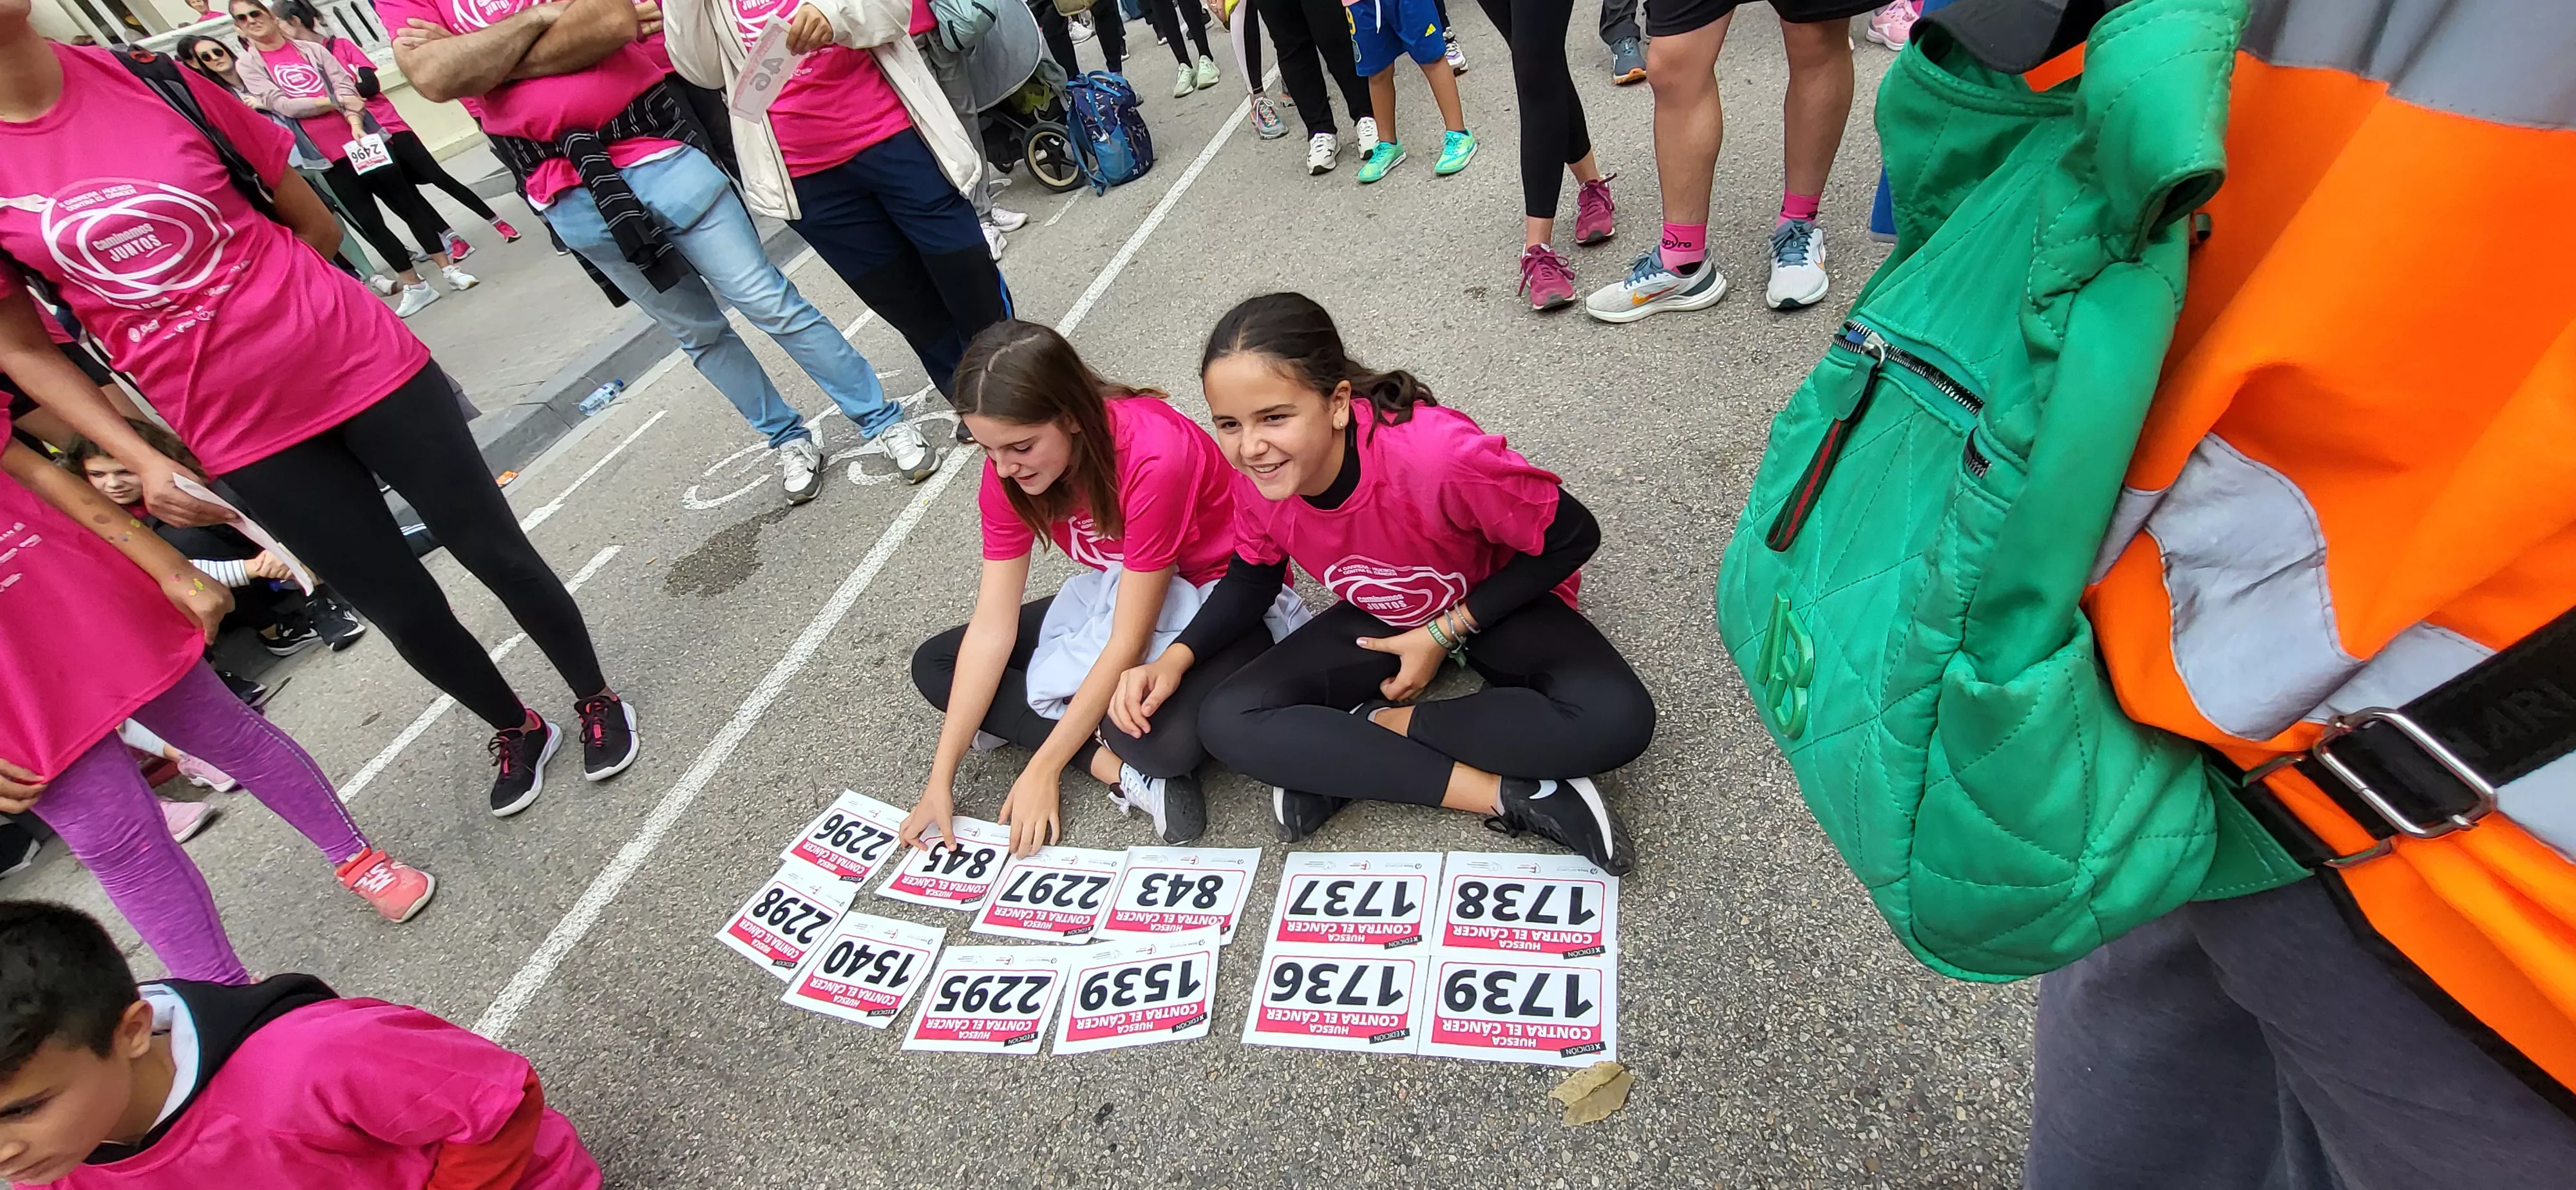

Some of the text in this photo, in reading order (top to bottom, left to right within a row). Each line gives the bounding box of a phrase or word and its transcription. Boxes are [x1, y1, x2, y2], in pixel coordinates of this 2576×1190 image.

[352, 144, 381, 163] 2496
[110, 234, 163, 262] JUNTOS
[1662, 234, 1692, 249] spyro
[1367, 600, 1407, 610] JUNTOS
[813, 814, 895, 861] 2296
[802, 841, 831, 858] CÁNCER
[817, 858, 837, 871] HUESCA
[837, 857, 865, 874] CONTRA
[921, 840, 996, 879] 845
[901, 875, 987, 893] CONTRA EL CÁNCER
[999, 870, 1111, 909] 2297
[1137, 873, 1224, 909] 843
[925, 889, 952, 898] HUESCA
[1289, 880, 1416, 917] 1737
[1456, 882, 1595, 925] 1738
[752, 888, 833, 944] 2298
[994, 906, 1091, 925] CONTRA EL CÁNCER
[1023, 920, 1053, 929] HUESCA
[1115, 911, 1225, 925] CONTRA EL CÁNCER
[1150, 923, 1183, 932] HUESCA
[1287, 921, 1412, 934] CONTRA EL CÁNCER
[1453, 925, 1593, 944] CONTRA EL CÁNCER
[739, 918, 799, 959] CONTRA EL CÁNCER
[750, 939, 772, 954] HUESCA
[1327, 934, 1365, 942] HUESCA
[1499, 940, 1540, 950] HUESCA
[824, 941, 915, 988] 1540
[810, 978, 896, 1006] CONTRA EL CÁNCER
[1080, 959, 1201, 1011] 1539
[1271, 962, 1403, 1006] 1736
[833, 995, 860, 1007] HUESCA
[934, 975, 1052, 1014] 2295
[1444, 970, 1593, 1019] 1739
[925, 1019, 1032, 1032] CONTRA EL CÁNCER
[1076, 1003, 1197, 1030] CONTRA EL CÁNCER
[1266, 1008, 1399, 1026] CONTRA EL CÁNCER
[958, 1031, 991, 1039] HUESCA
[1117, 1021, 1153, 1033] HUESCA
[1309, 1024, 1349, 1035] HUESCA
[1443, 1019, 1591, 1040] CONTRA EL CÁNCER
[1492, 1036, 1537, 1048] HUESCA
